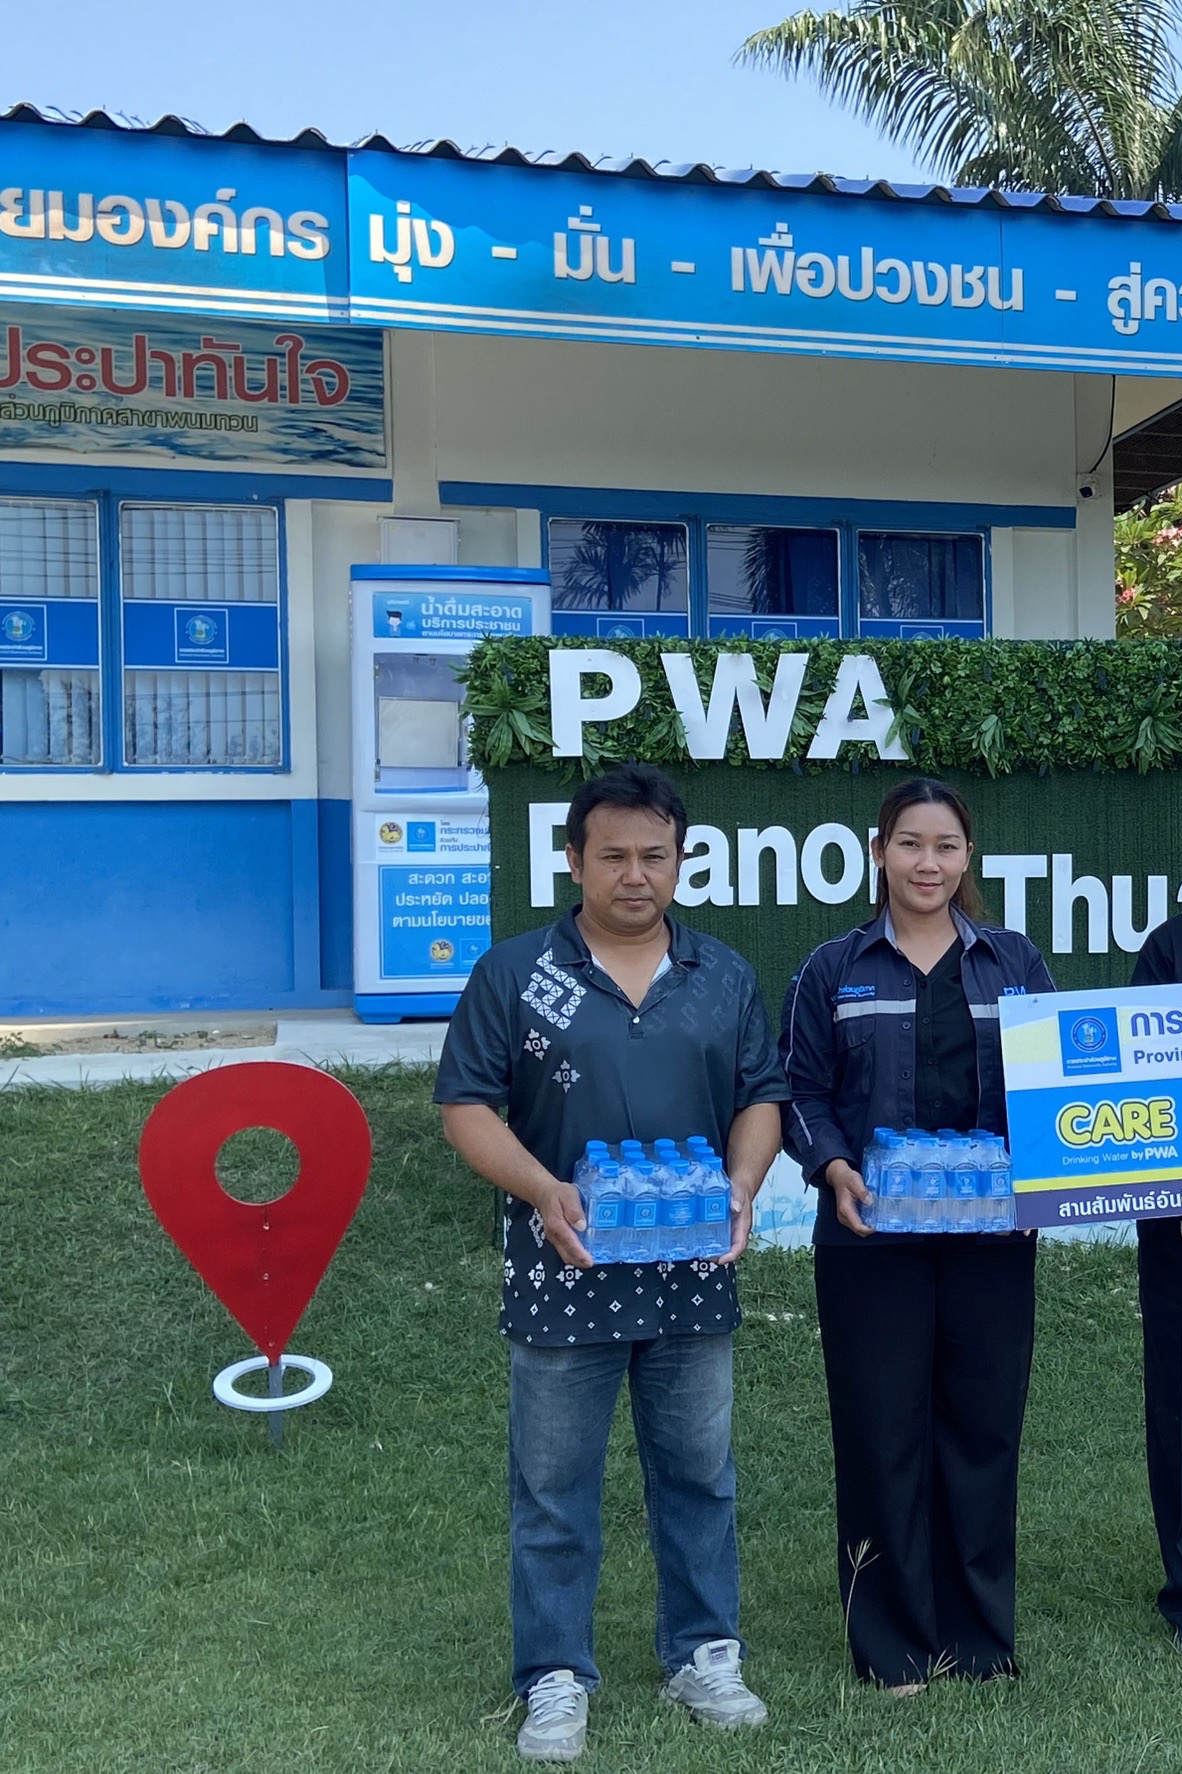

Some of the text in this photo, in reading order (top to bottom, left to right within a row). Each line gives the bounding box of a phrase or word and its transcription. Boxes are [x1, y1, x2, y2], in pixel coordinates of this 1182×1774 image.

[369, 202, 455, 283] มุ่ง
[554, 205, 636, 284] มั่น
[731, 222, 1024, 313] เพื่อปวงชน
[549, 649, 910, 760] PWA
[409, 873, 455, 885] สะดวก
[528, 801, 881, 908] Pano
[395, 891, 453, 906] ประหยัด
[1058, 1098, 1176, 1147] CARE
[1062, 1154, 1100, 1166] Drinking
[1102, 1152, 1129, 1162] Water
